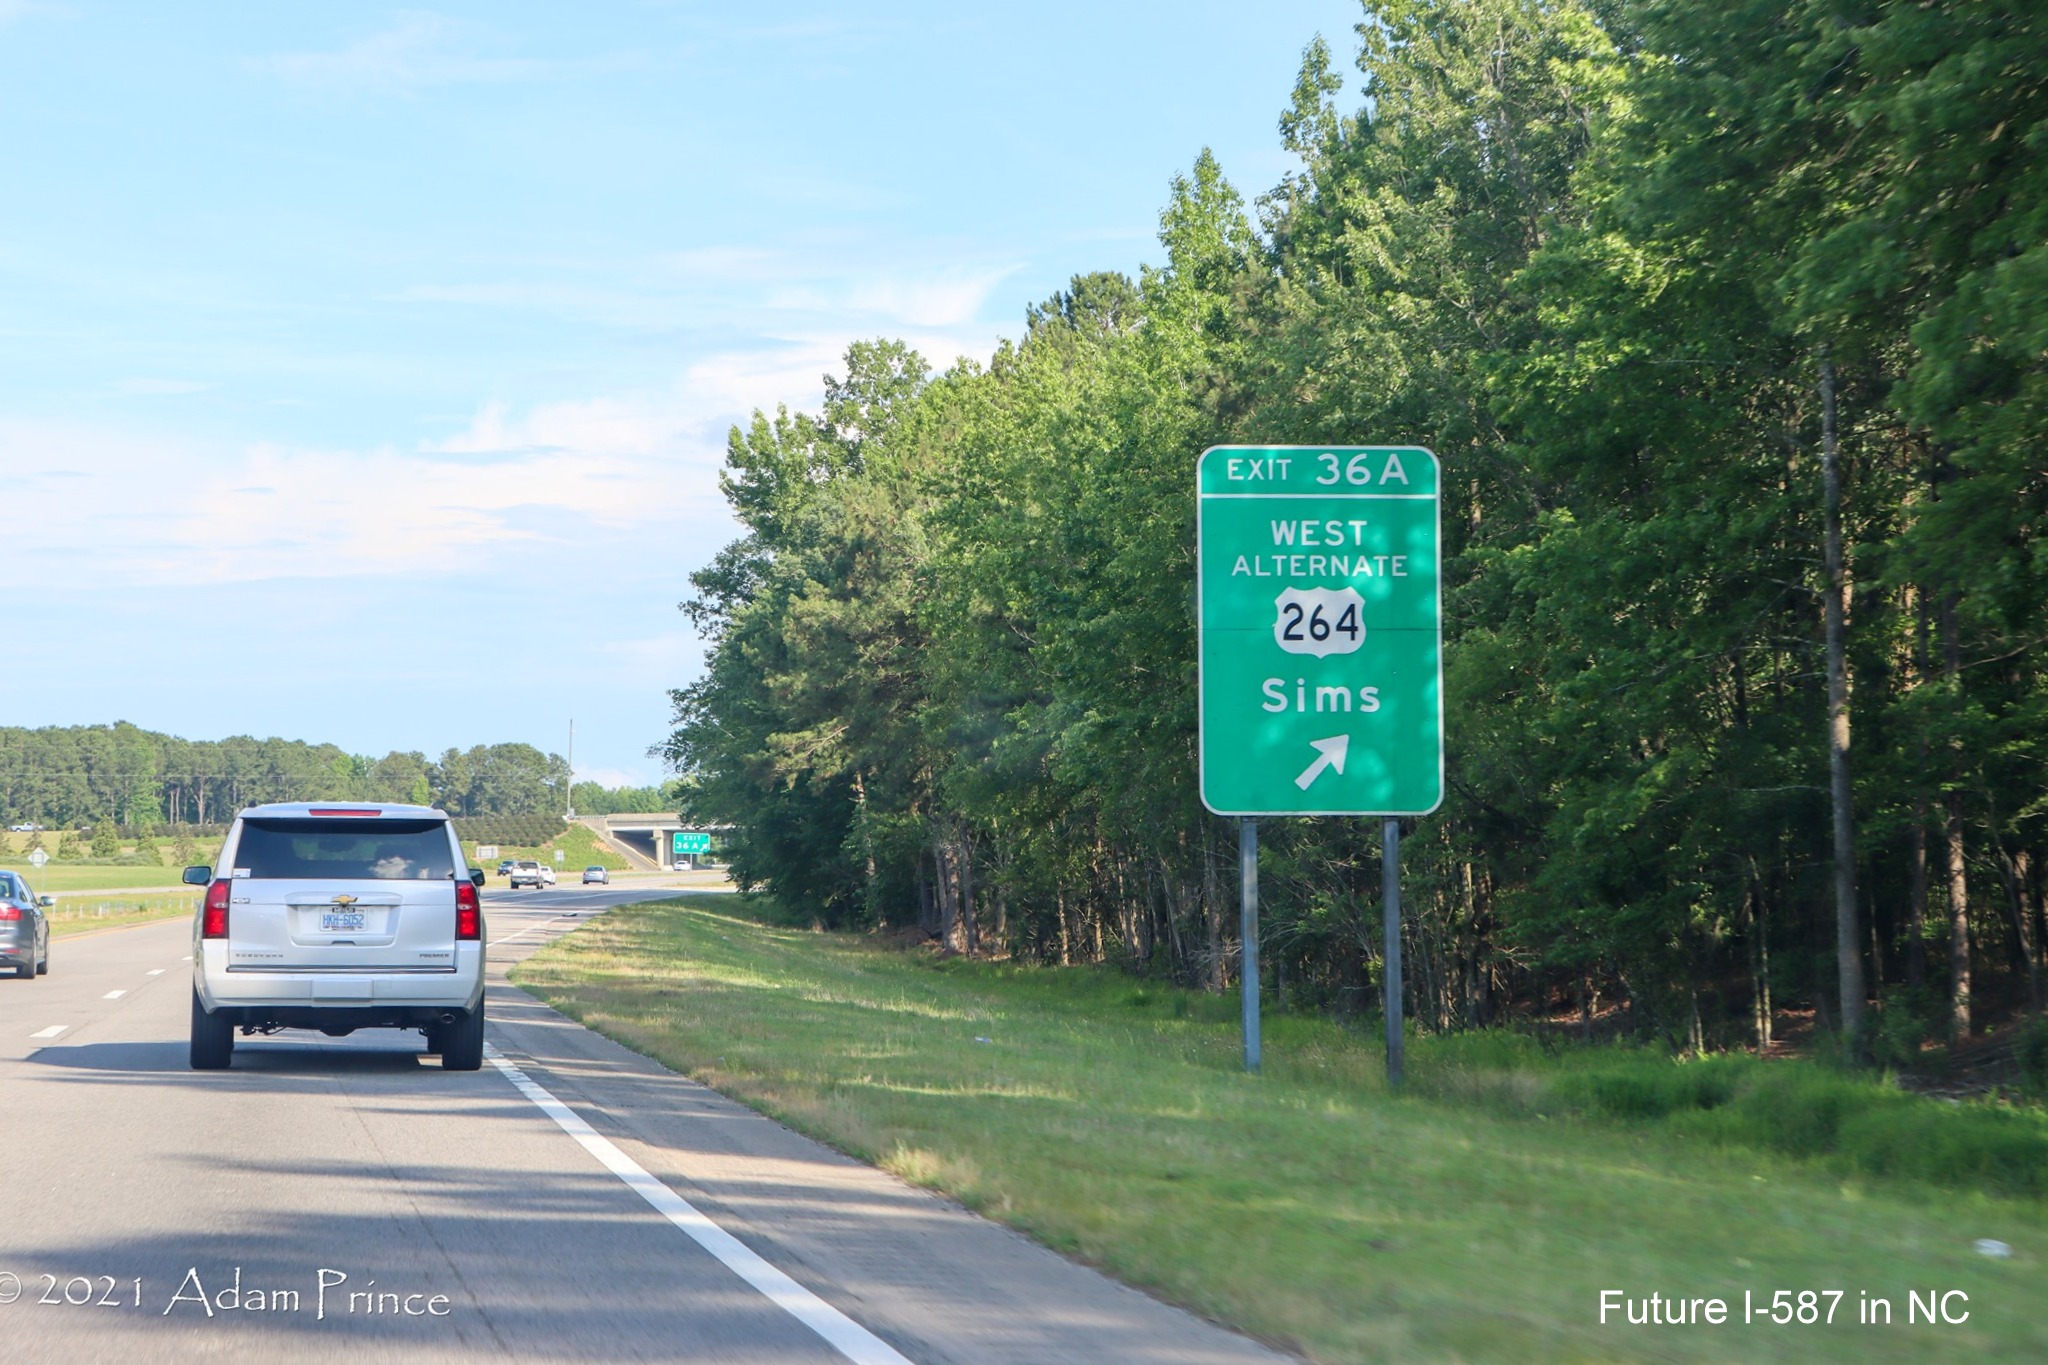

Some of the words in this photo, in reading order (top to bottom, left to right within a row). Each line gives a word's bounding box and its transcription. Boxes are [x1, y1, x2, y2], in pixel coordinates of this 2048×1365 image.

[1227, 458, 1292, 481] EXIT
[1271, 520, 1367, 546] WEST
[1231, 555, 1408, 577] ALTERNATE
[1283, 602, 1359, 642] 264
[1261, 677, 1381, 713] Sims
